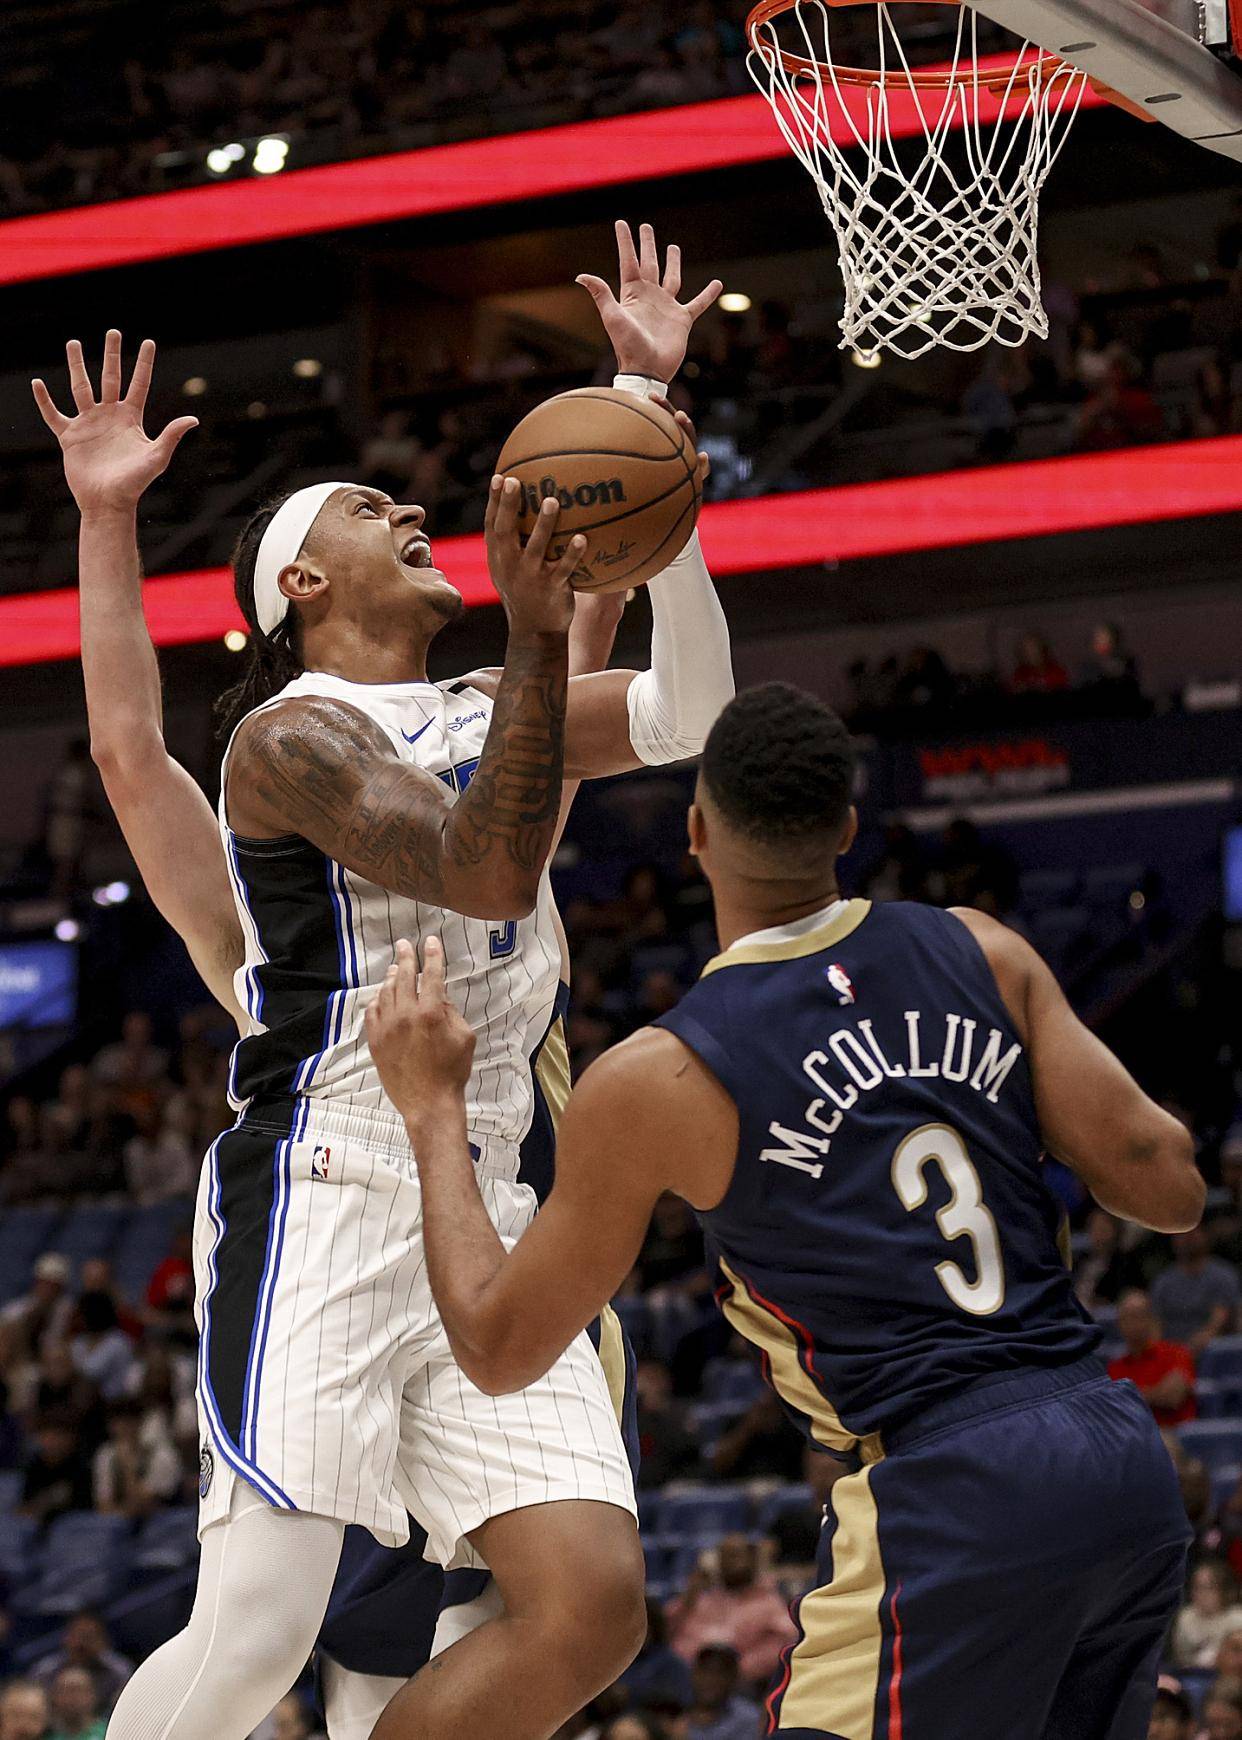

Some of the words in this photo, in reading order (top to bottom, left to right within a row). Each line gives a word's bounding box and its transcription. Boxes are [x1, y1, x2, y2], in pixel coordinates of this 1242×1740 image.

[518, 475, 627, 518] ilson
[759, 1010, 1023, 1180] McCOLLUM
[890, 1122, 1006, 1316] 3
